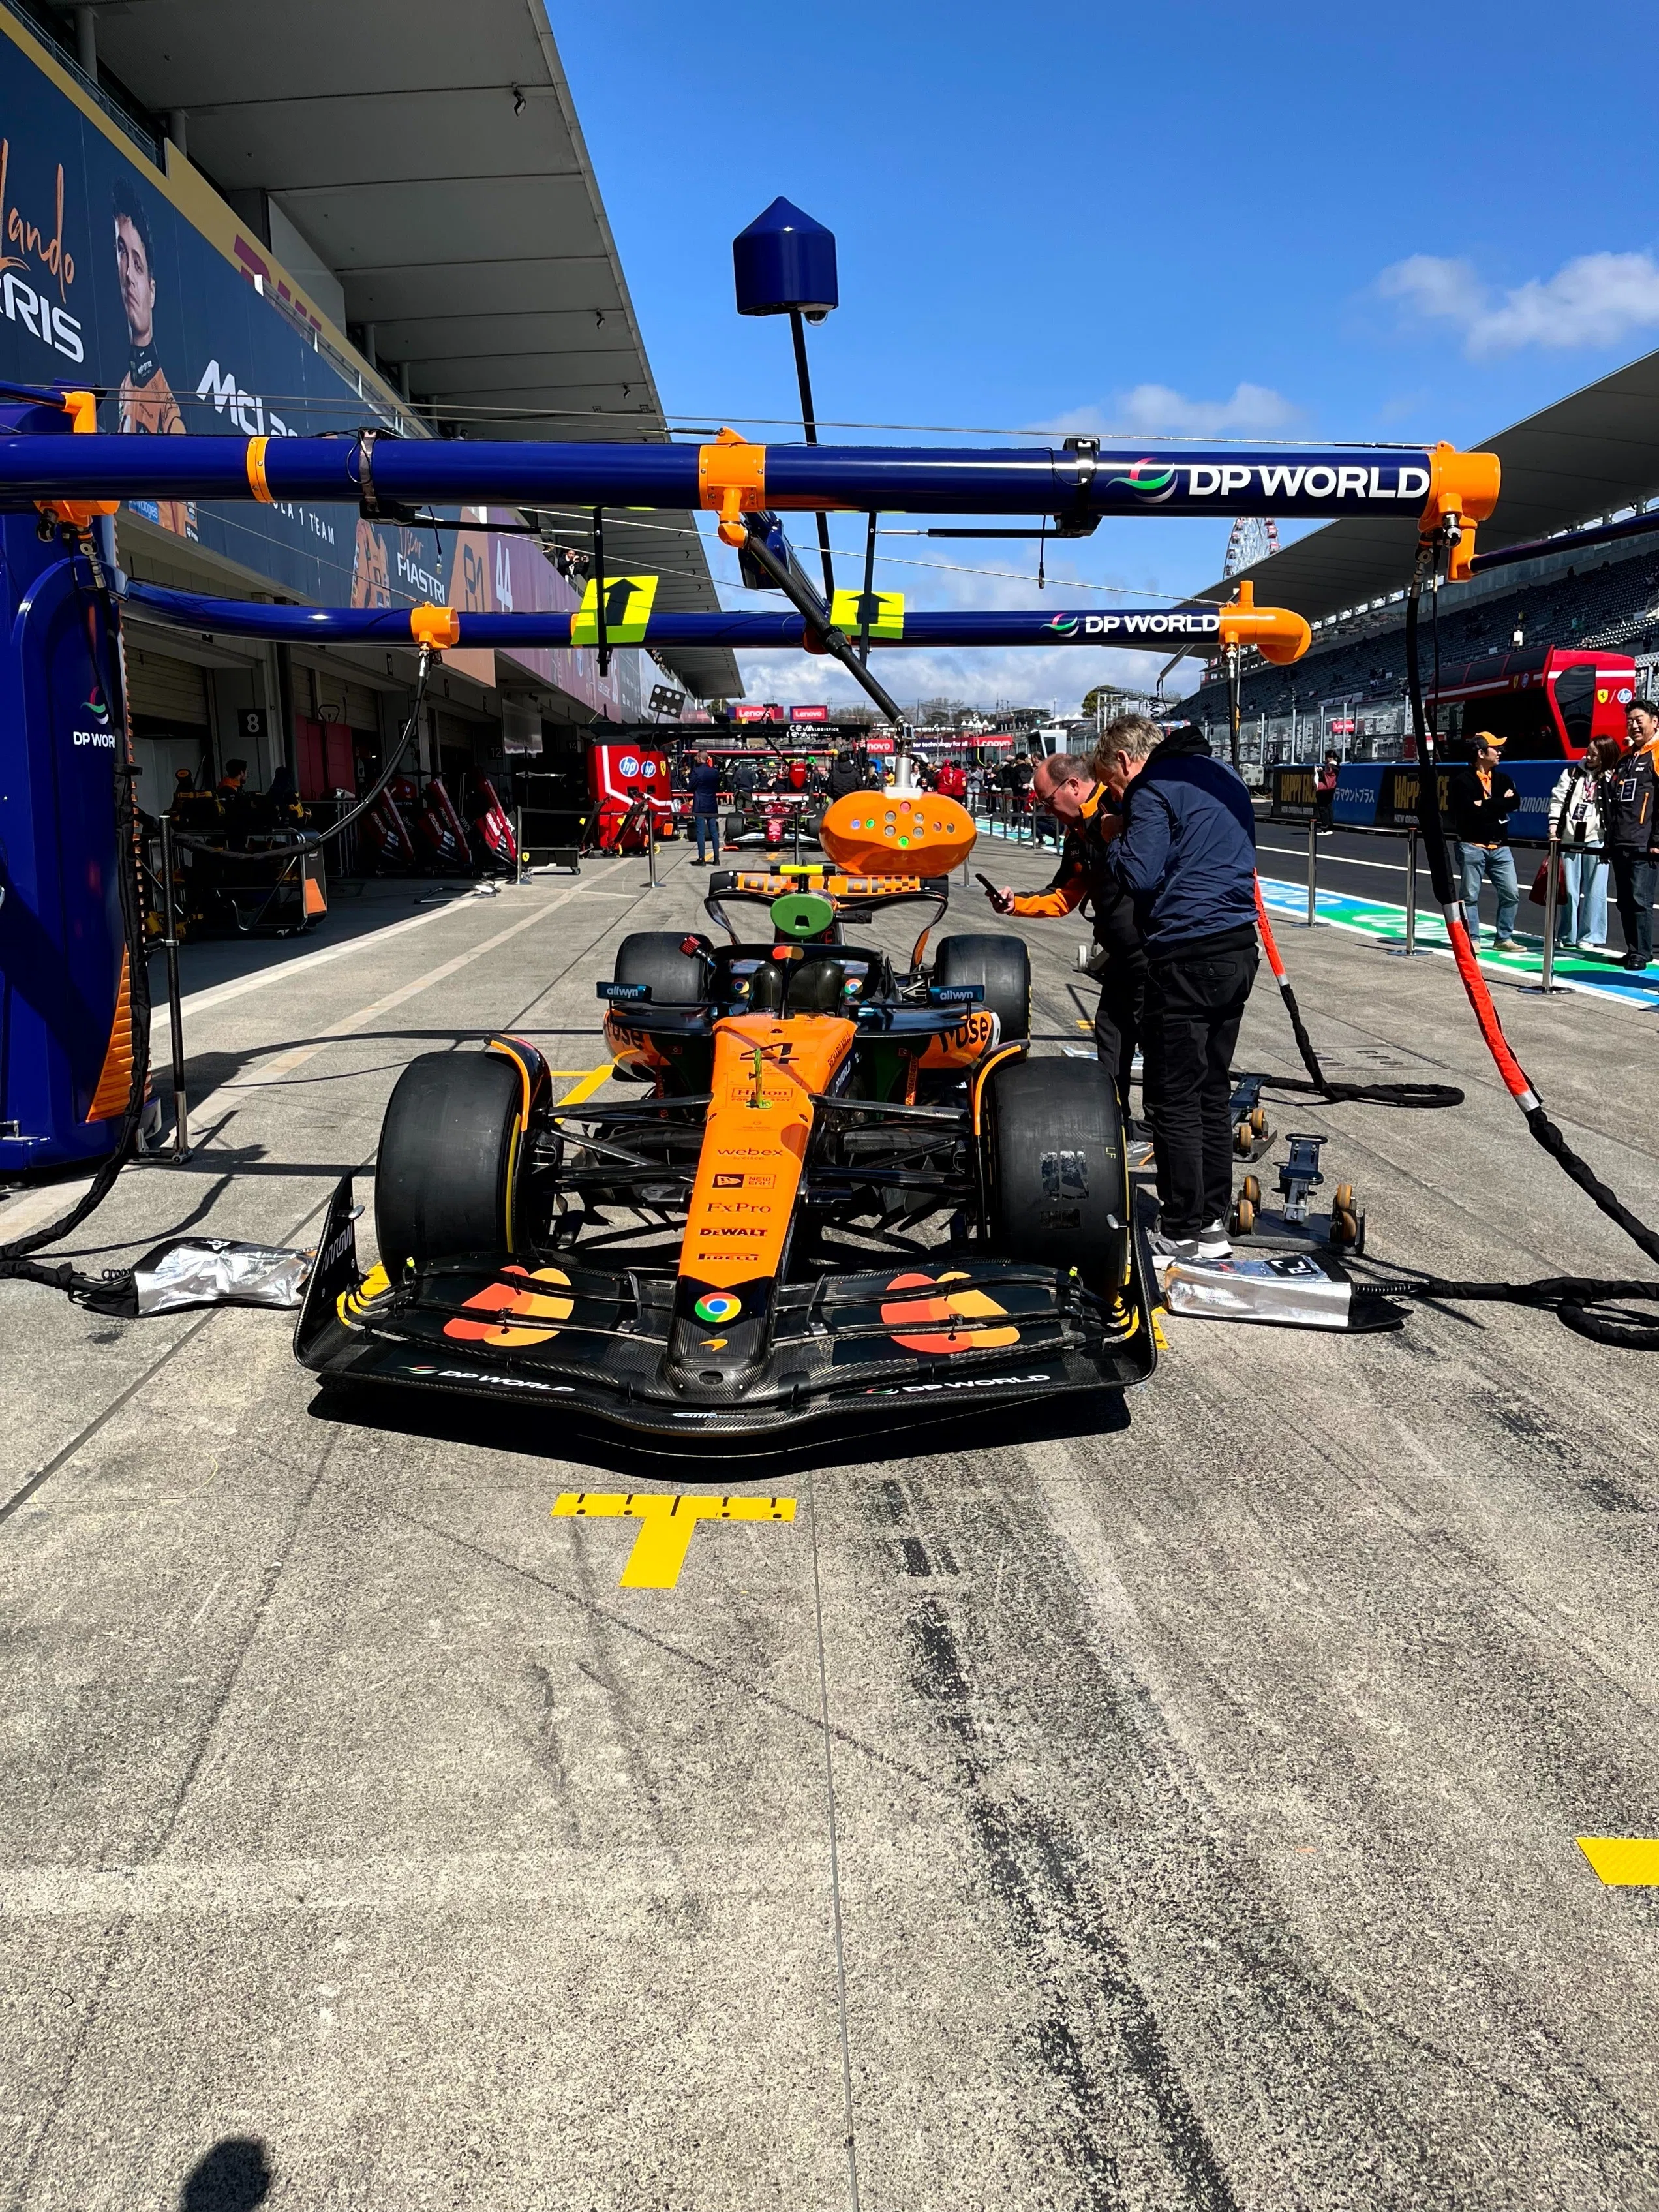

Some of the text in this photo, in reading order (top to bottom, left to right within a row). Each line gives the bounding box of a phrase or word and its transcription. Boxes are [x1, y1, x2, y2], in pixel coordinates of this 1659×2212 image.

[0, 273, 84, 363] RIS
[1189, 465, 1430, 499] DP WORLD
[309, 513, 335, 545] TEAM
[397, 552, 445, 605] PIASTRI
[1086, 615, 1220, 633] DP WORLD
[247, 713, 259, 733] 8
[73, 731, 115, 748] DP WOR
[491, 748, 502, 758] 12
[622, 757, 637, 777] hp
[1394, 775, 1421, 810] HAPP
[1405, 814, 1420, 825] ORIG
[607, 986, 638, 998] allwyn
[939, 990, 973, 1001] allwyn
[707, 1203, 772, 1213] FxPro
[479, 1375, 575, 1392] WORLD
[944, 1375, 1050, 1388] WORLD
